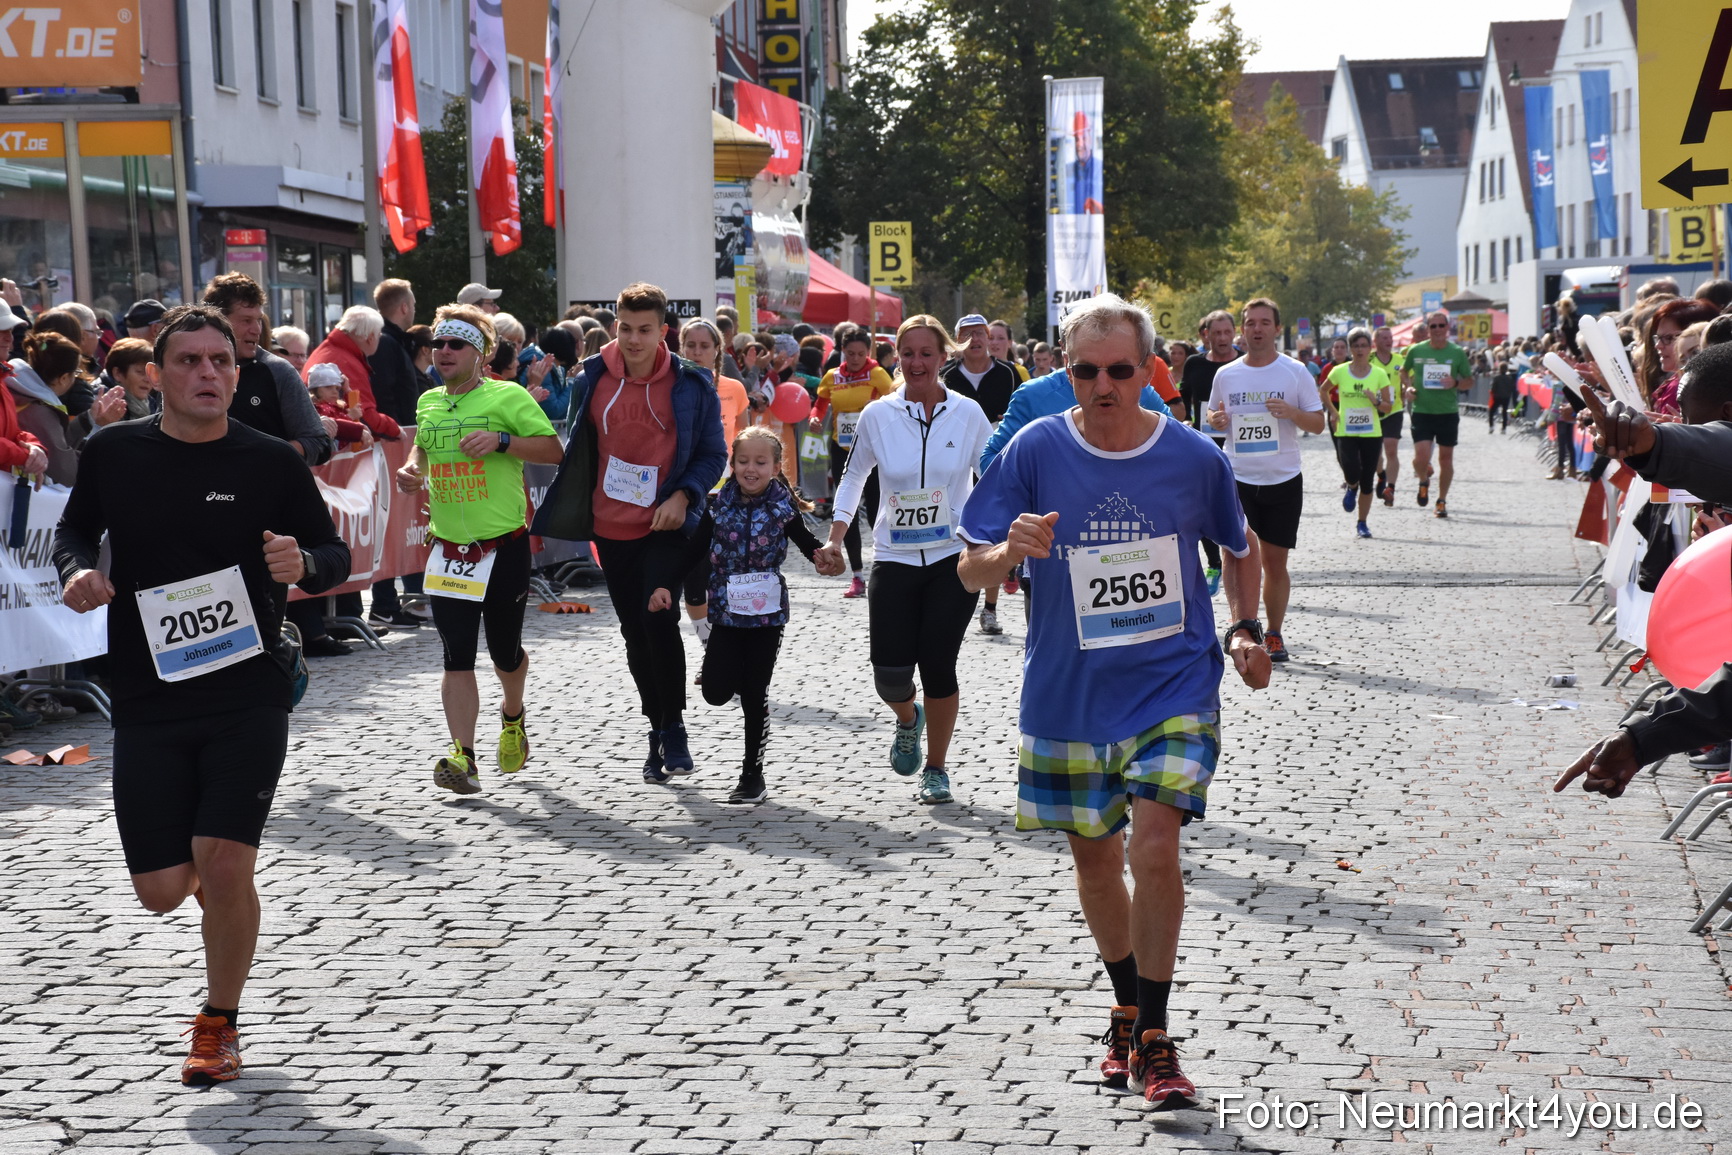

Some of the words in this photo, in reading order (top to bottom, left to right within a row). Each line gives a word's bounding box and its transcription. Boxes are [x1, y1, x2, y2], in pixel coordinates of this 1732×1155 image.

[874, 224, 907, 236] Block
[1682, 216, 1705, 248] B
[881, 242, 902, 272] B
[1160, 312, 1171, 329] C
[1479, 321, 1489, 334] D
[1349, 415, 1369, 424] 2256
[1239, 425, 1271, 440] 2759
[431, 460, 486, 478] MERZ
[610, 460, 638, 474] 3000
[433, 476, 487, 491] PREMIUM
[895, 505, 939, 526] 2767
[1111, 550, 1150, 562] BOCK
[177, 583, 213, 599] BOCK
[441, 579, 468, 589] Andreas
[1089, 569, 1167, 608] 2563
[160, 600, 238, 645] 2052
[1111, 612, 1155, 628] Heinrich
[183, 639, 233, 662] Johannes
